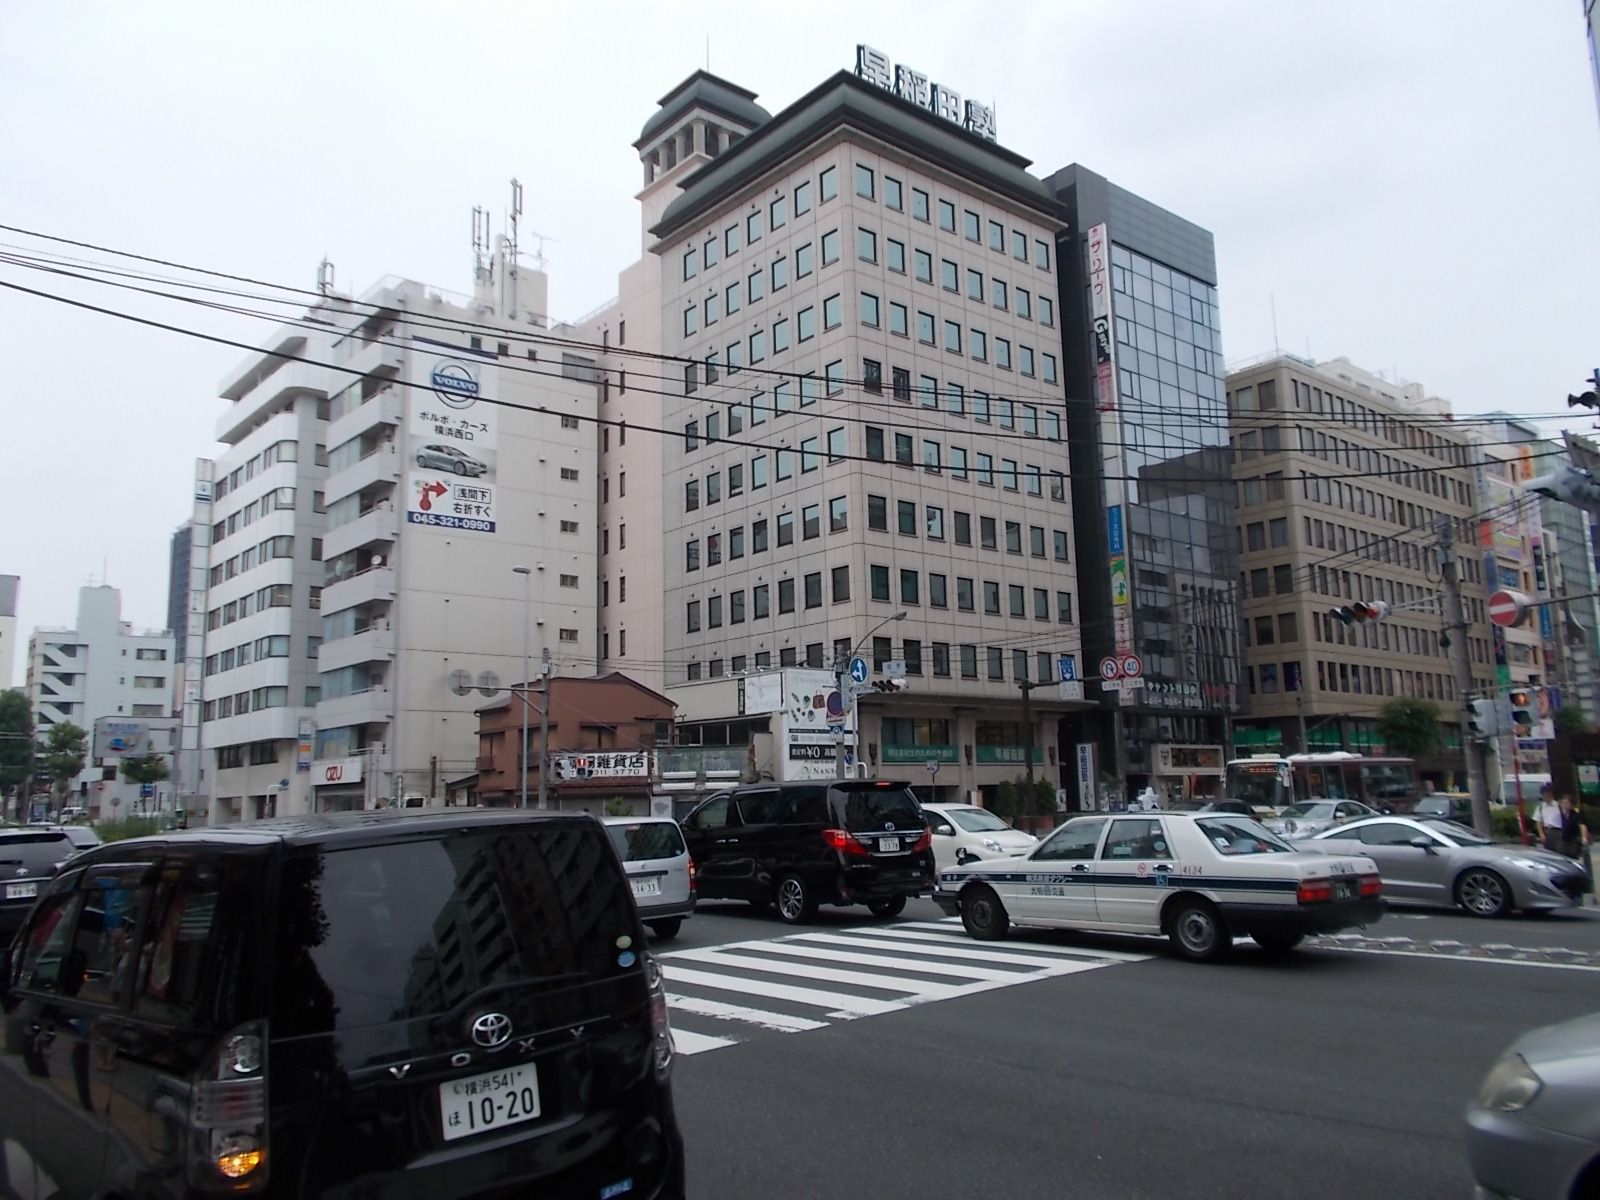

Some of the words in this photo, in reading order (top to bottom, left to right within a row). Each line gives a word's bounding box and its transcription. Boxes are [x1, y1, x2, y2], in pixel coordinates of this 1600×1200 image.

[857, 44, 997, 143] 早稲田塾
[436, 375, 478, 392] VOLVO
[434, 425, 474, 441] 横浜西口
[453, 503, 491, 518] 右折すぐ
[412, 513, 491, 531] 045-321-0990
[1127, 661, 1138, 672] 40
[389, 1026, 585, 1079] VOXY
[468, 1087, 535, 1130] 10-20
